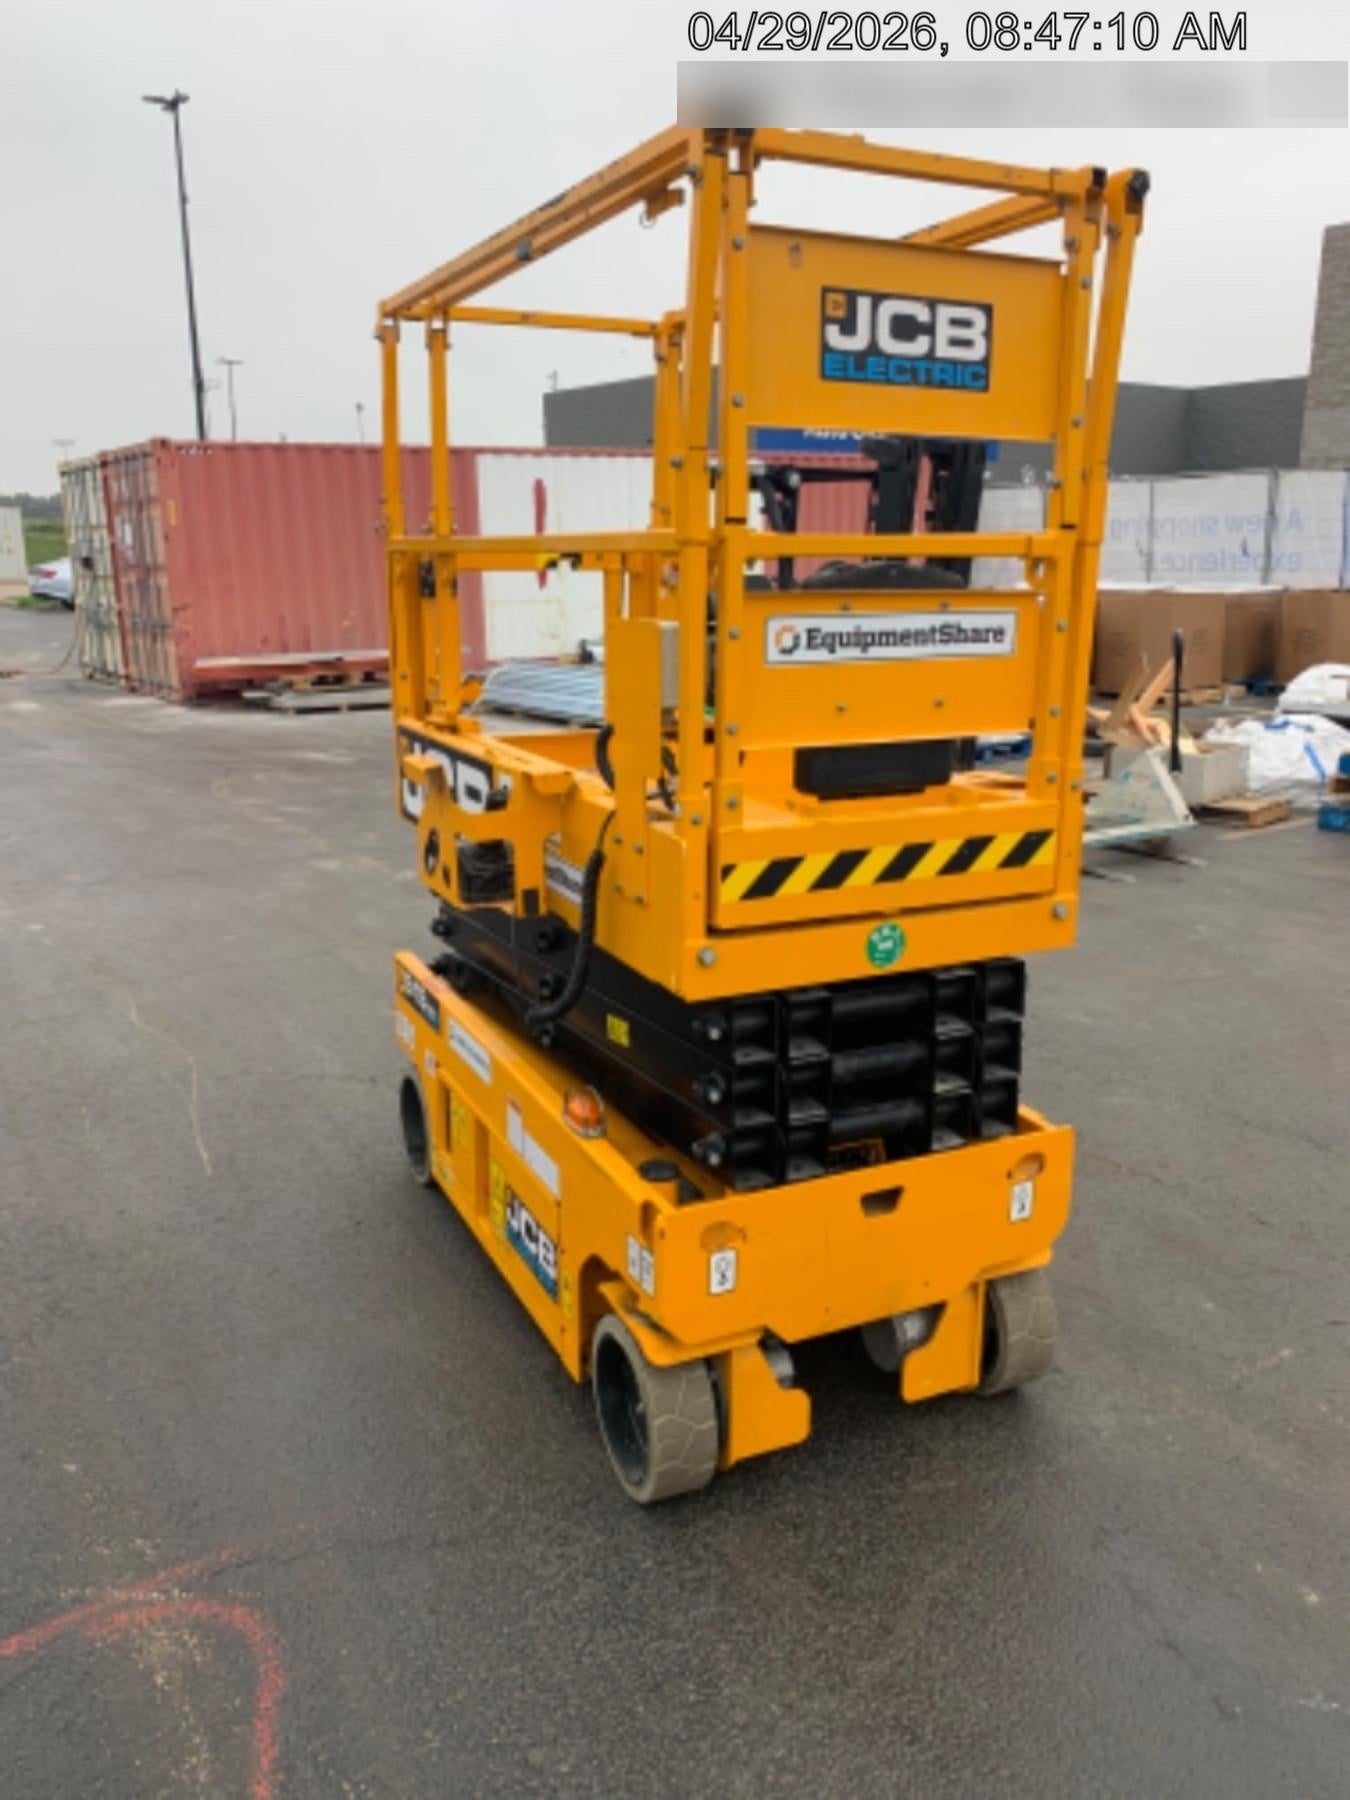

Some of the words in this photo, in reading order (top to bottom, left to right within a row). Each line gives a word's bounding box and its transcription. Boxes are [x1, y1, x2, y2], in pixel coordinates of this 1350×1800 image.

[824, 294, 988, 361] JCB
[823, 352, 987, 391] ELECTRIC
[805, 622, 1006, 655] EquipmentShare
[507, 1198, 558, 1280] JCB
